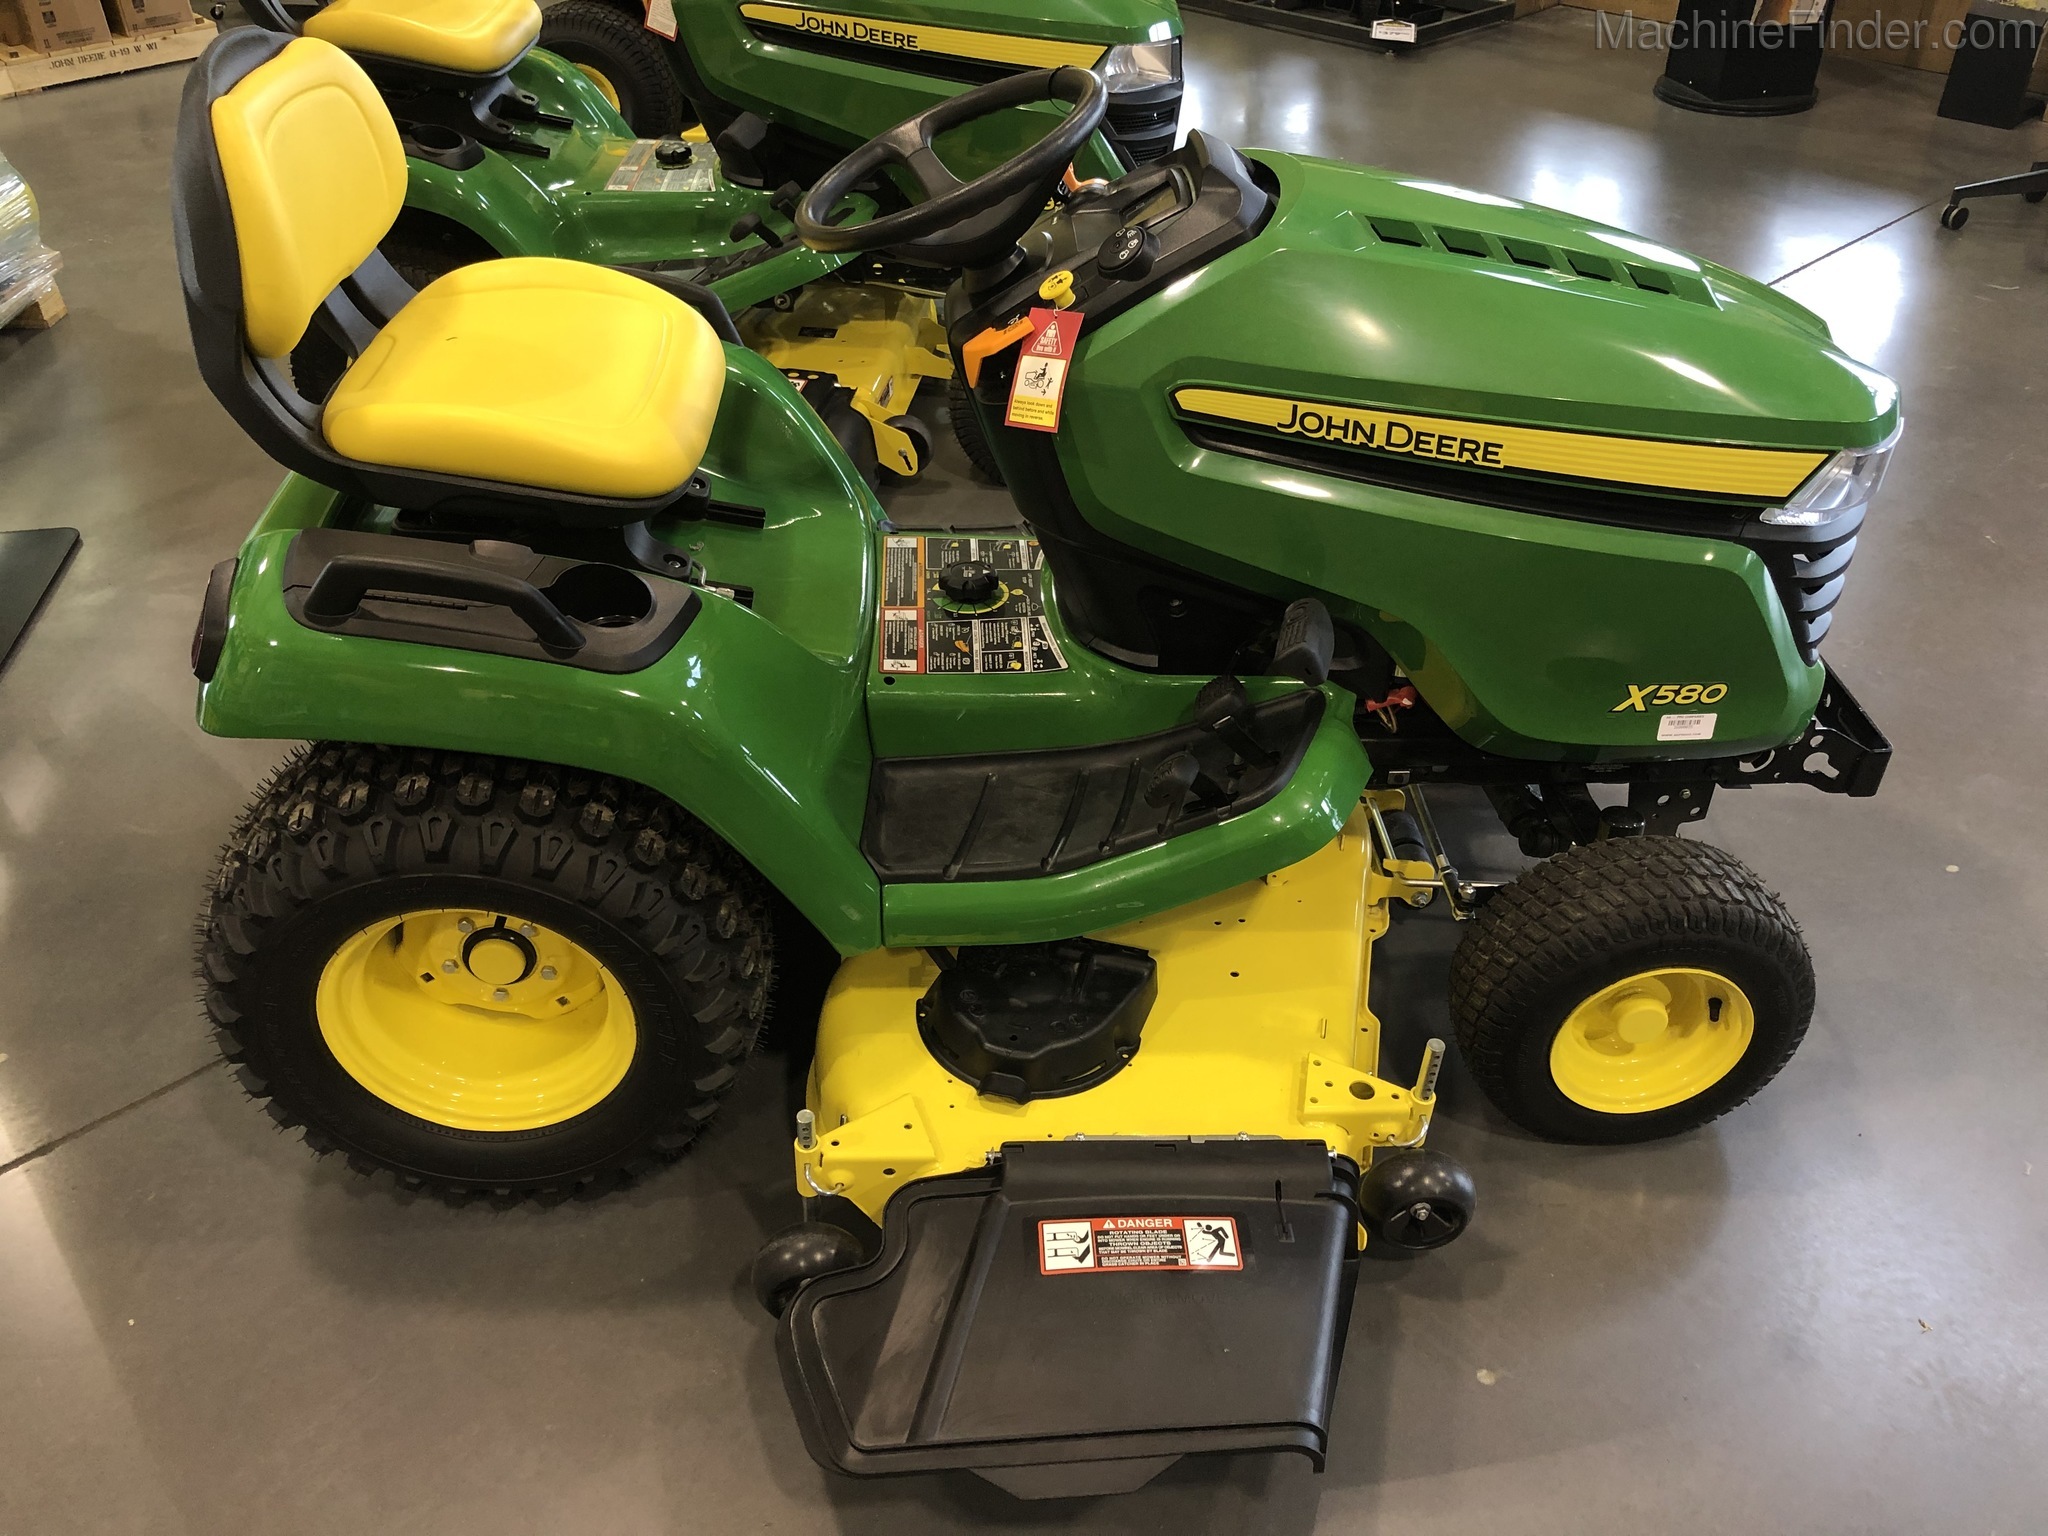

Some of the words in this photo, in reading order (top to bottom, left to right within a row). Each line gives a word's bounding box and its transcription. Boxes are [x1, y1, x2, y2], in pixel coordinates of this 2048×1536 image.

[796, 12, 848, 36] JOHN
[853, 22, 918, 48] DEERE
[50, 58, 74, 70] JOHN
[78, 52, 105, 64] DEERE
[1040, 336, 1057, 346] SAFETY
[1277, 404, 1376, 445] JOHN
[1384, 421, 1504, 464] DEERE
[1609, 683, 1729, 712] X580
[1118, 1219, 1173, 1227] DANGER
